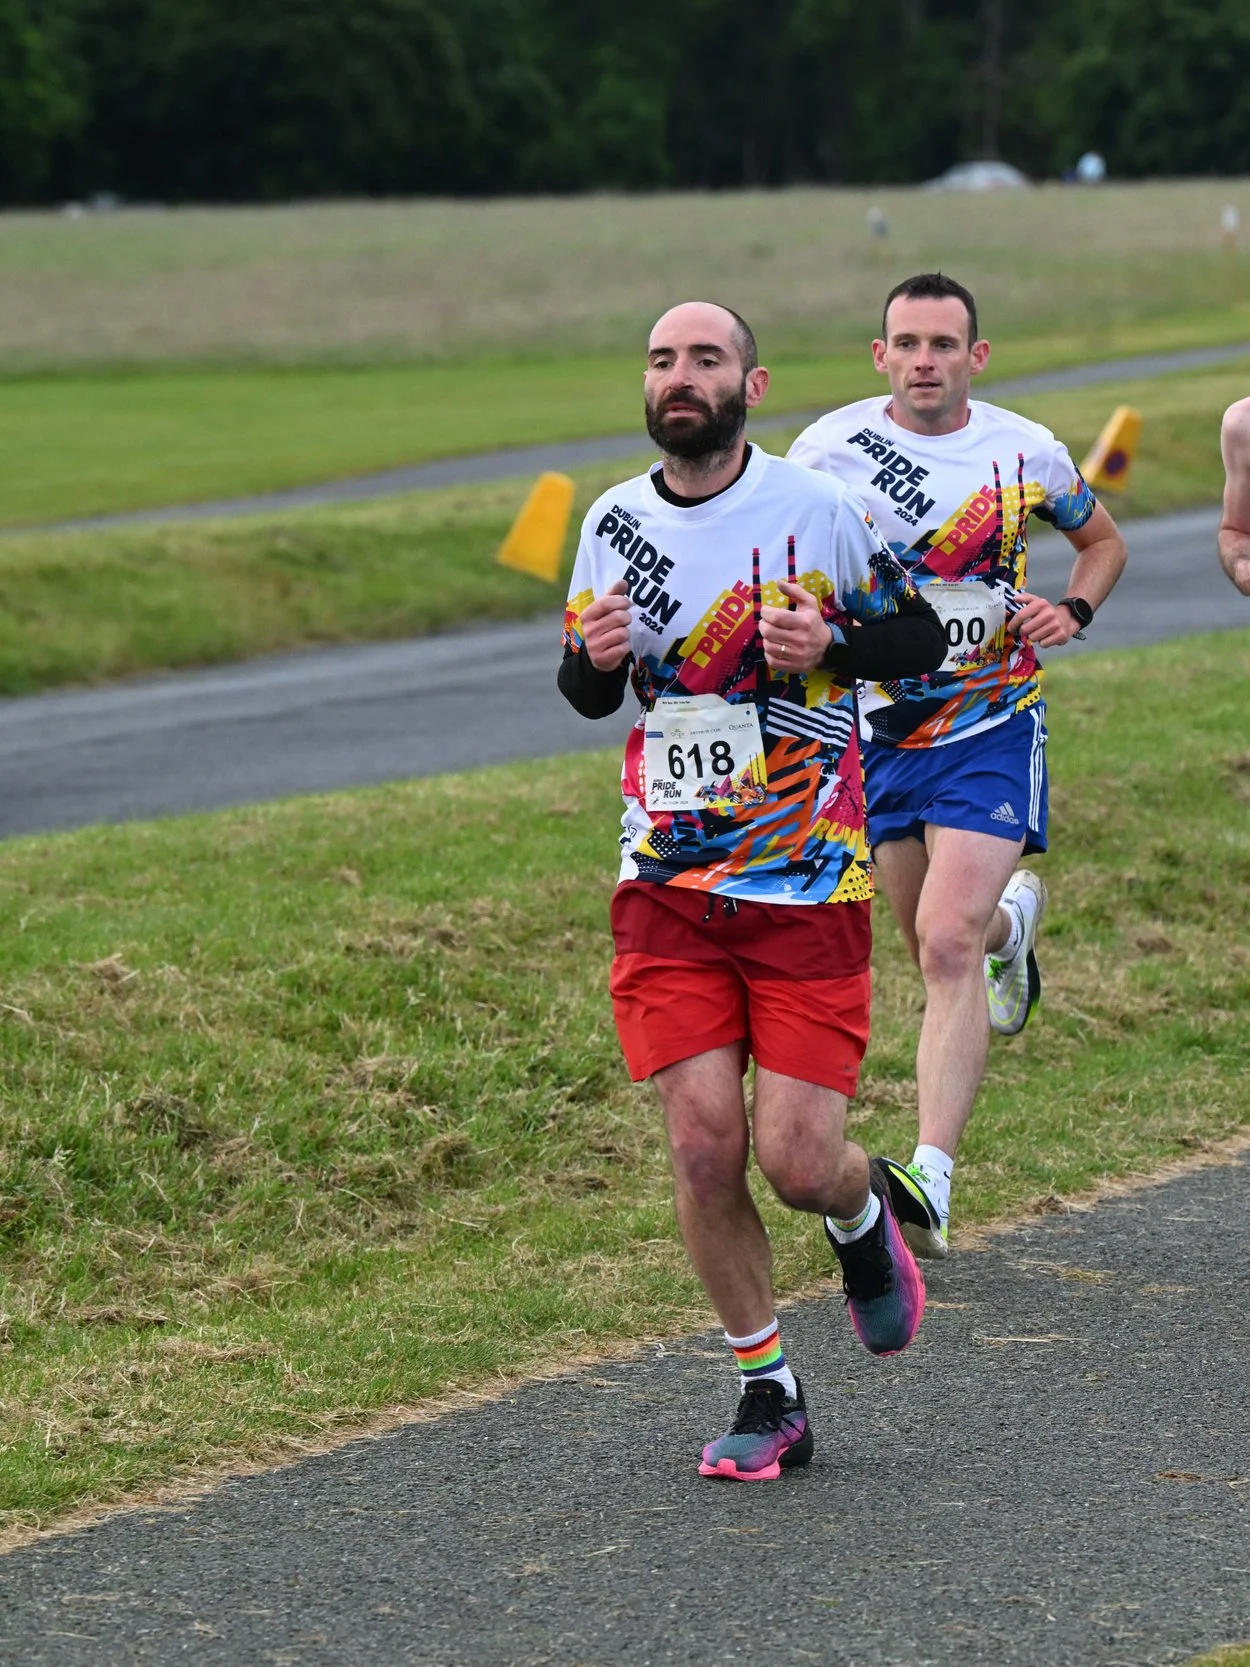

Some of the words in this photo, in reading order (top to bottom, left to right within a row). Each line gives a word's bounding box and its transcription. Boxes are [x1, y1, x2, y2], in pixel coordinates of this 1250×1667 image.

[862, 428, 894, 447] DUBLIN
[846, 432, 930, 487] PRIDE
[870, 468, 936, 519] RUN
[611, 504, 641, 531] DUBLIN
[894, 507, 919, 526] 2024
[946, 484, 997, 546] PRIDE
[595, 512, 675, 586] PRIDE
[622, 564, 682, 626] RUN
[639, 613, 664, 635] 2024
[696, 579, 753, 660] PRIDE
[668, 740, 735, 780] 618
[652, 782, 676, 790] PRIDE
[663, 789, 682, 798] RUN
[806, 817, 859, 849] RUN
[990, 812, 1019, 825] adidas
